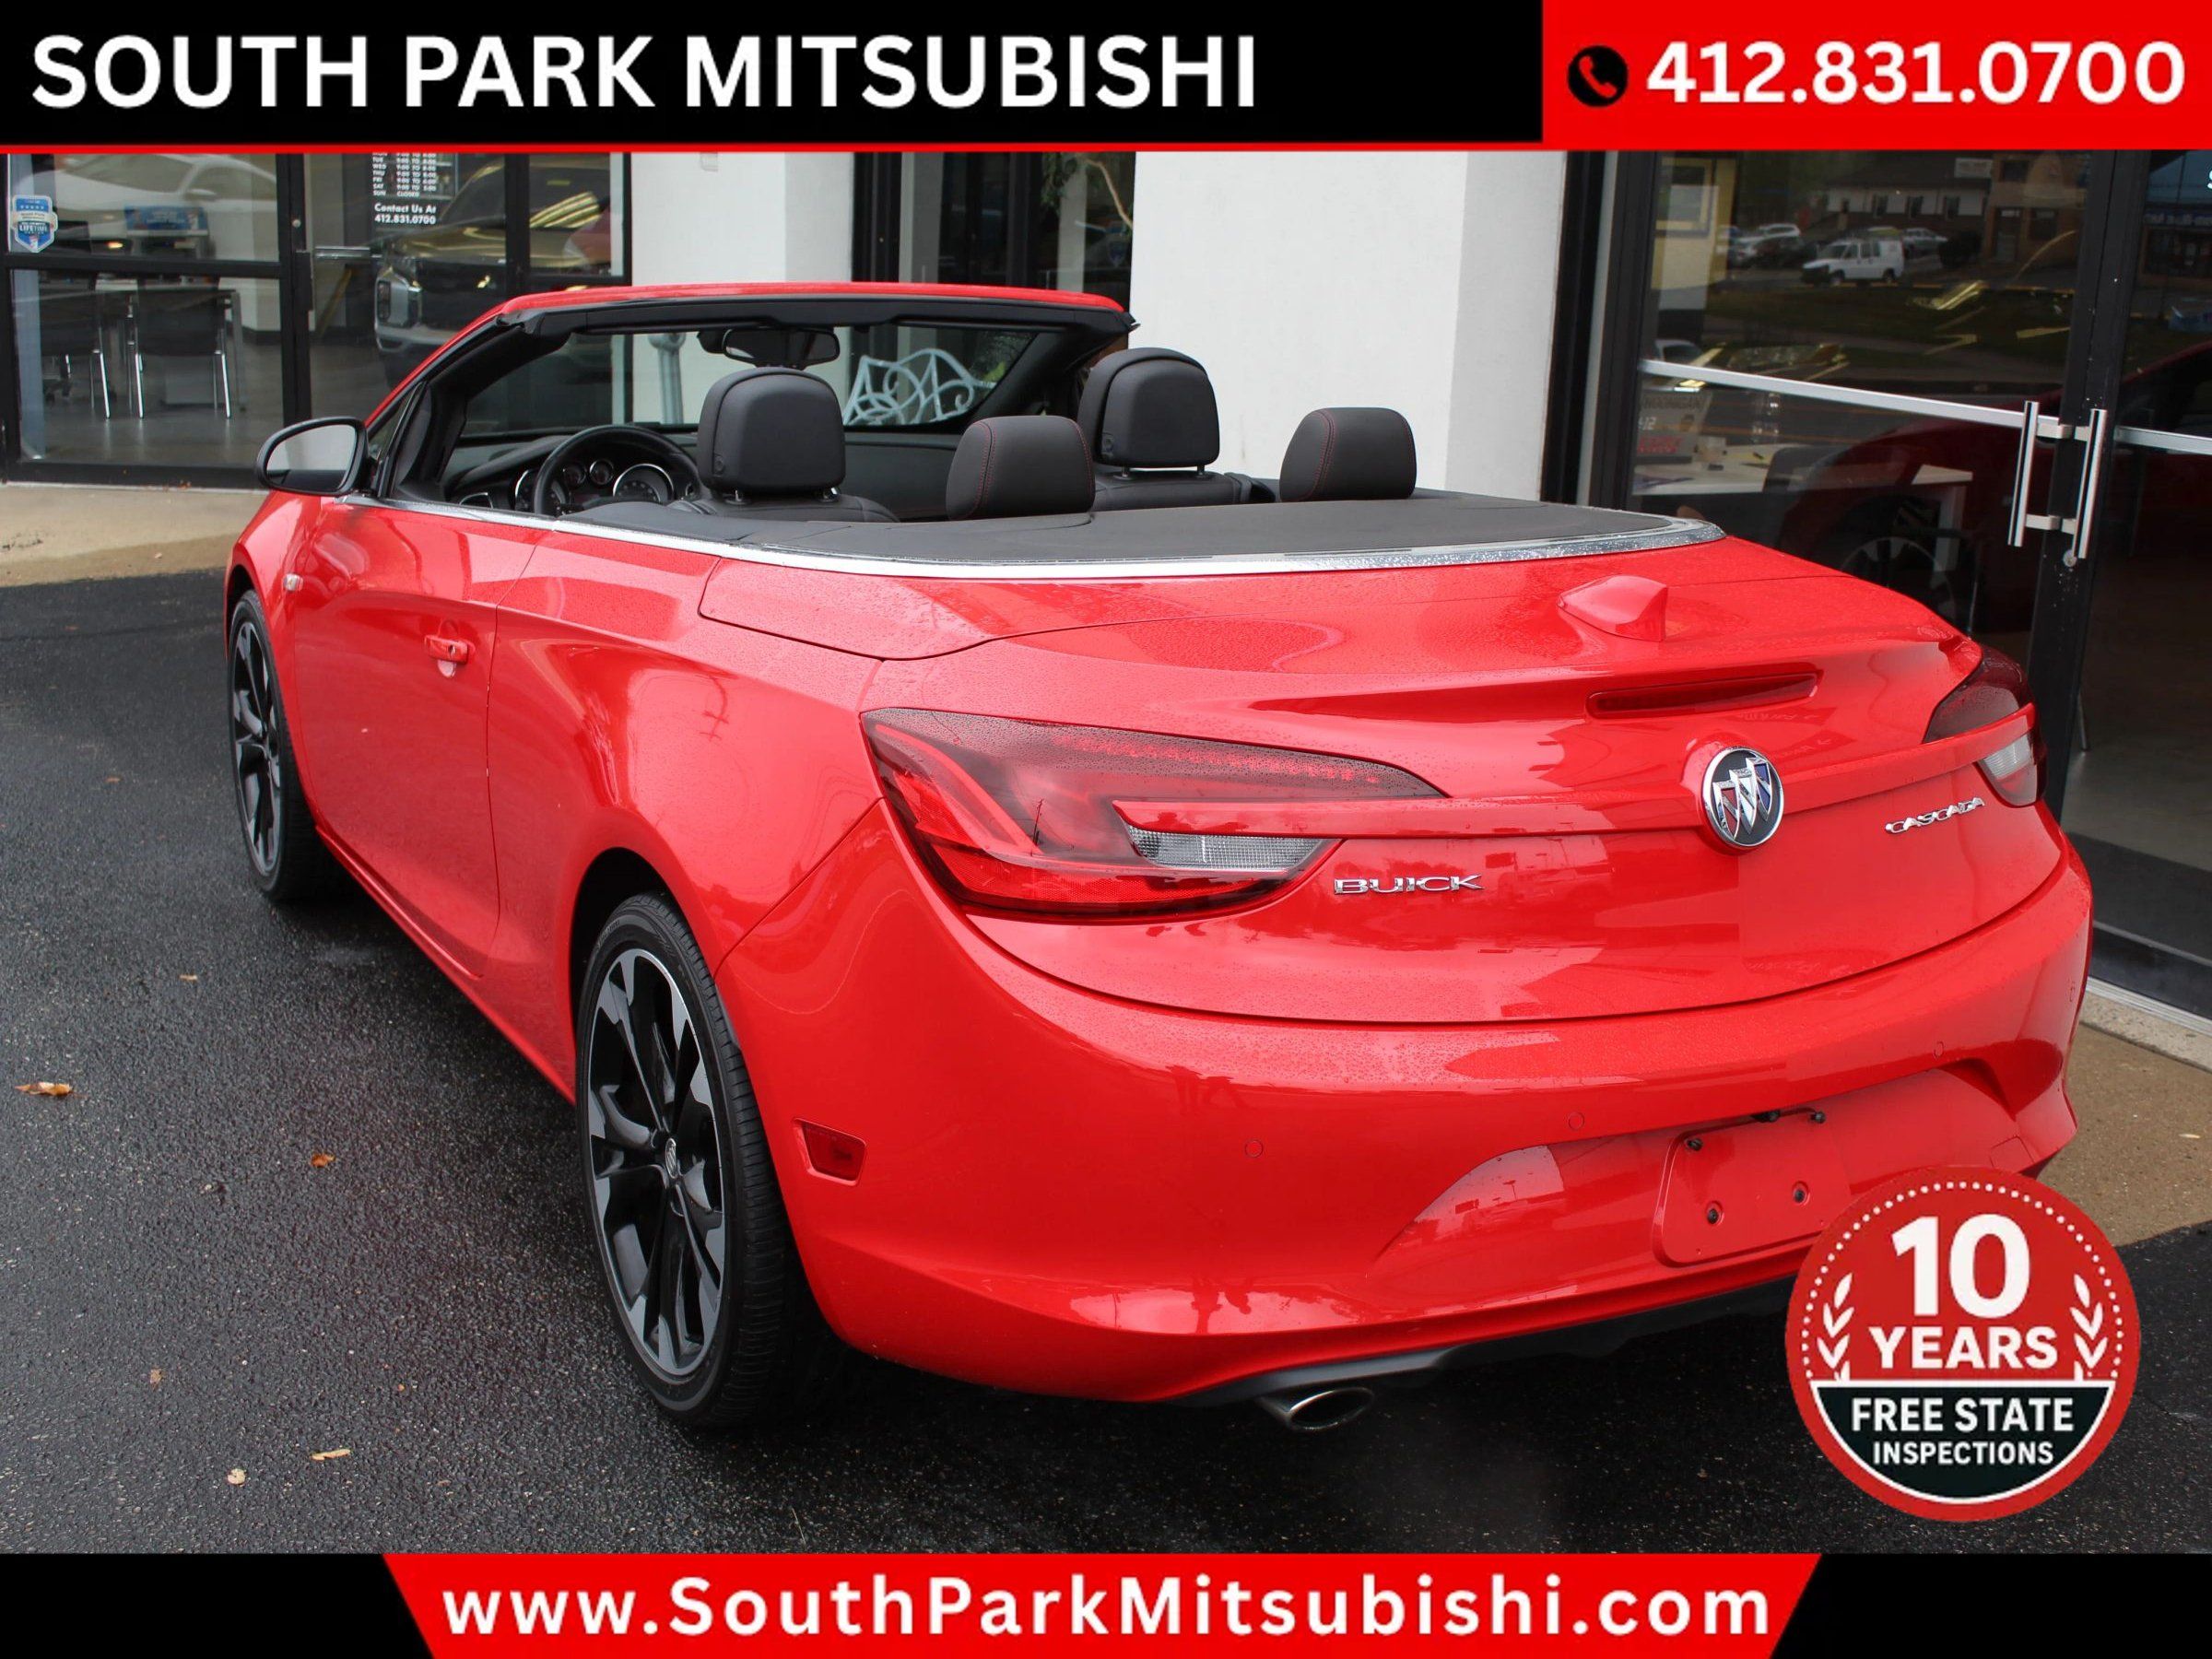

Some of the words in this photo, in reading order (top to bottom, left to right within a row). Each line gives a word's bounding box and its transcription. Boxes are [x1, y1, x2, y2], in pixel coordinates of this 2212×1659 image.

[374, 202, 408, 213] Contact
[411, 204, 423, 213] Us
[426, 205, 437, 214] At
[374, 214, 437, 225] 412.831.0700
[1885, 797, 1986, 834] CASCADA
[1334, 874, 1486, 896] BUICK
